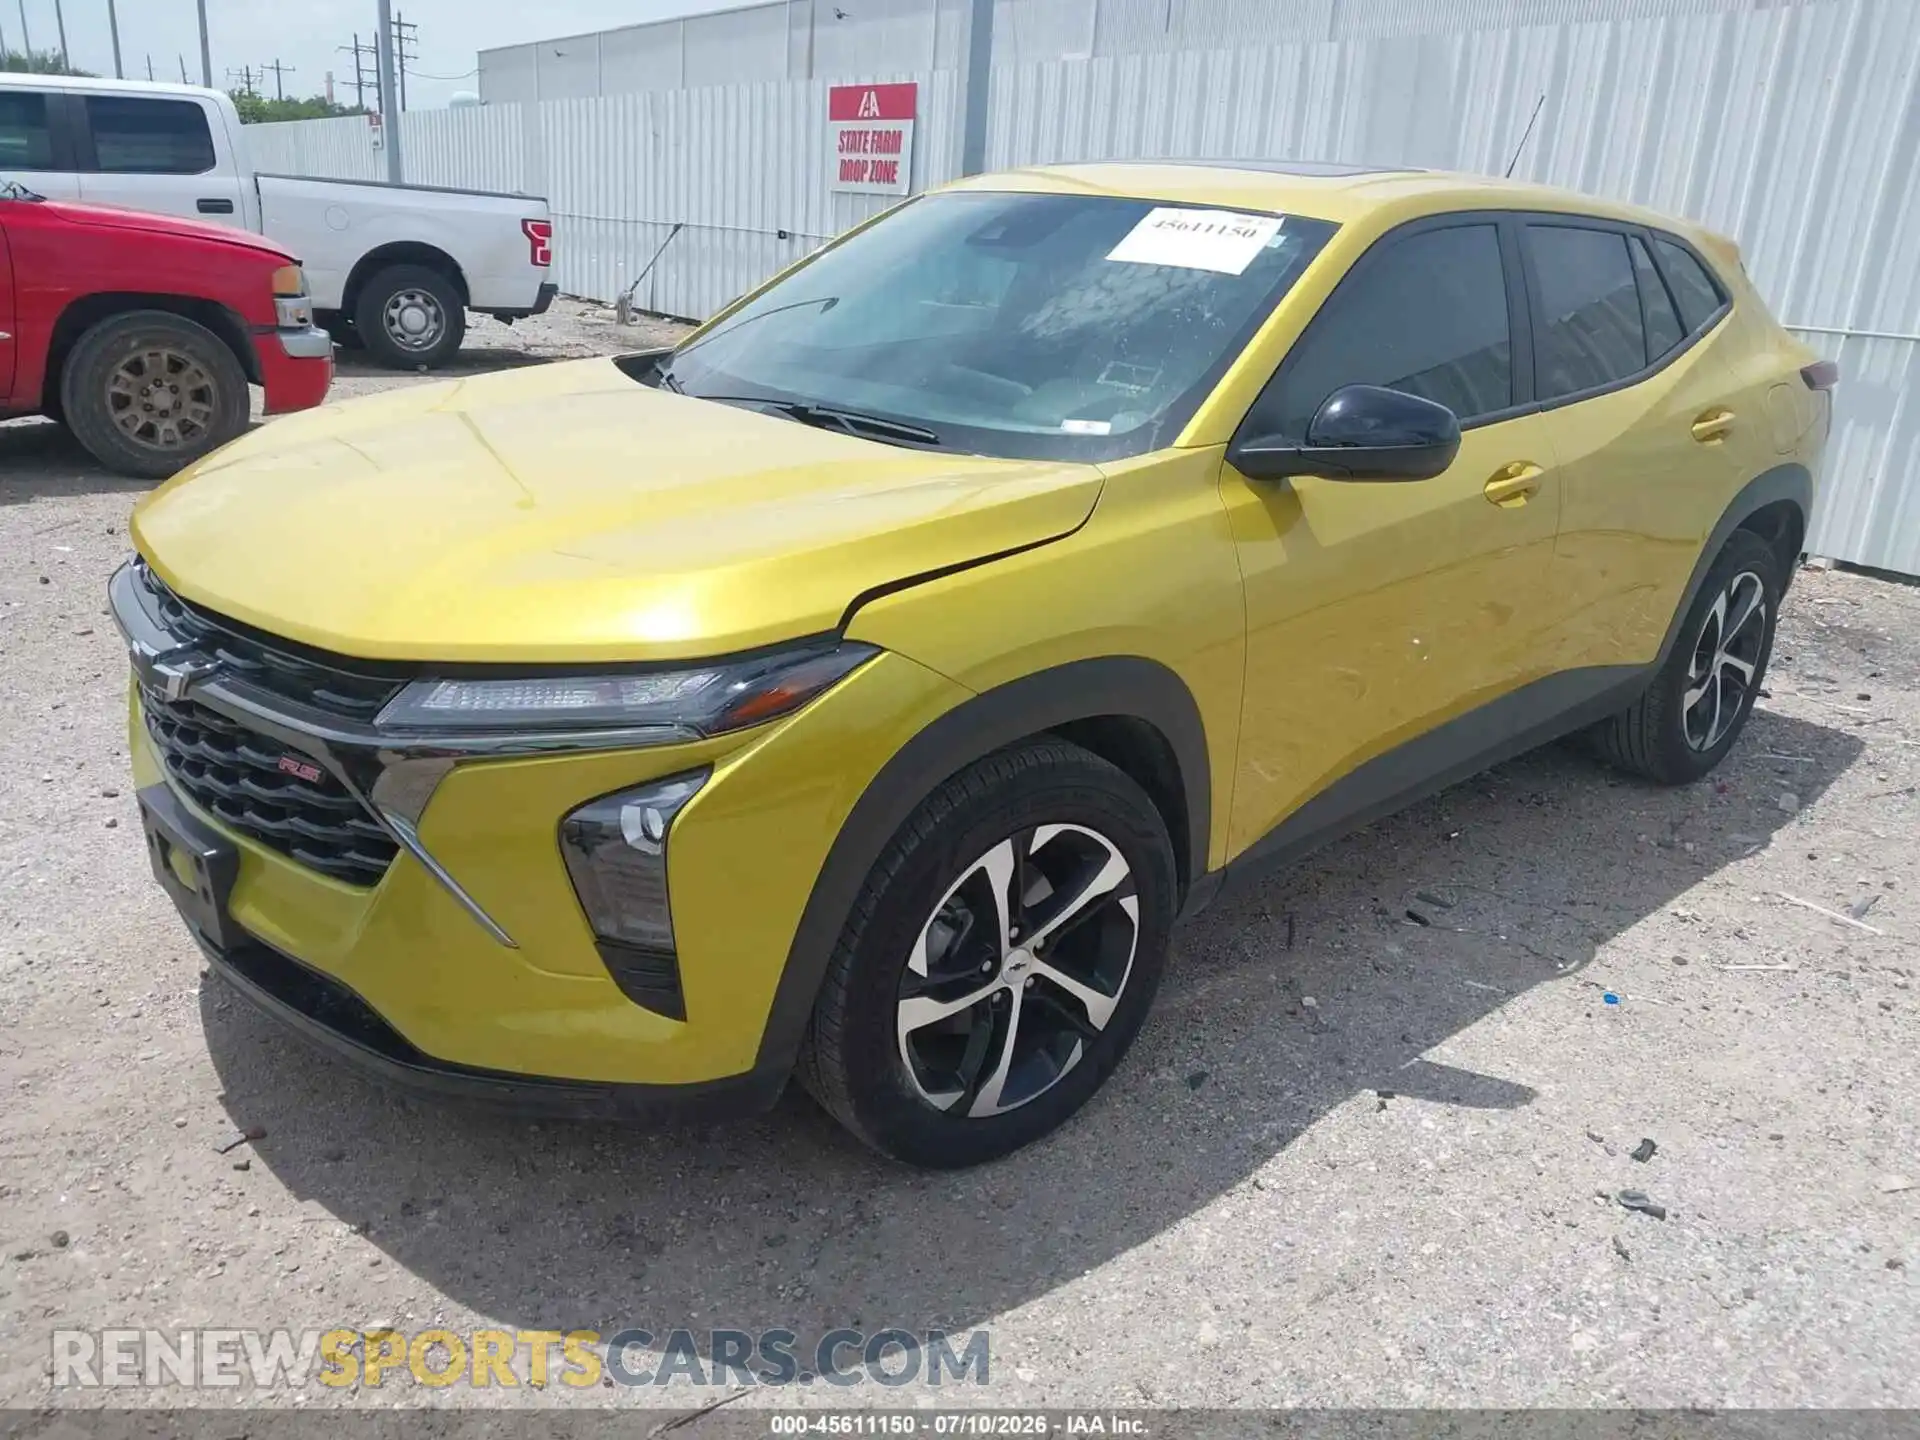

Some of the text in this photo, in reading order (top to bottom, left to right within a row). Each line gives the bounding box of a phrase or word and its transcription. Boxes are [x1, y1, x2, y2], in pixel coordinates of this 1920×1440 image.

[838, 130, 903, 154] STATE FARM
[839, 159, 899, 184] DROP ZONE
[1152, 219, 1257, 239] 45611150
